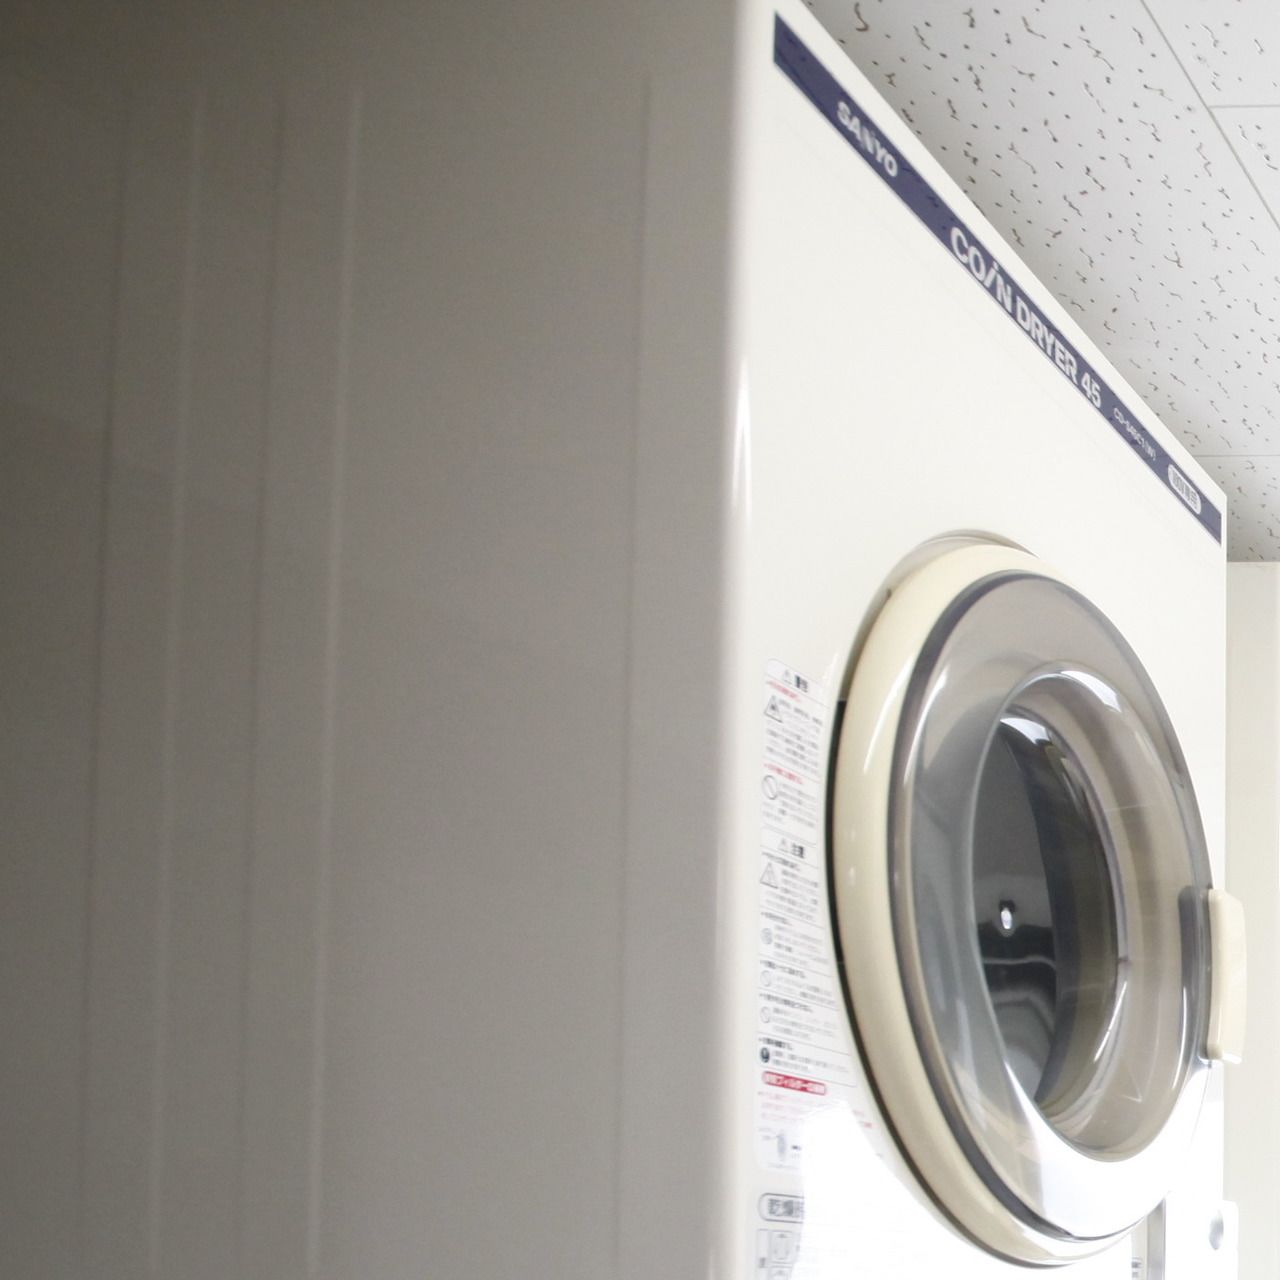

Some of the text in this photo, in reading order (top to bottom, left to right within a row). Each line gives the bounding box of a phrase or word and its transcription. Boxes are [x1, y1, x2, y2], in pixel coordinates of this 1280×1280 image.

[837, 101, 899, 178] SANYO
[1015, 294, 1079, 385] DRYER
[1080, 370, 1102, 410] 45
